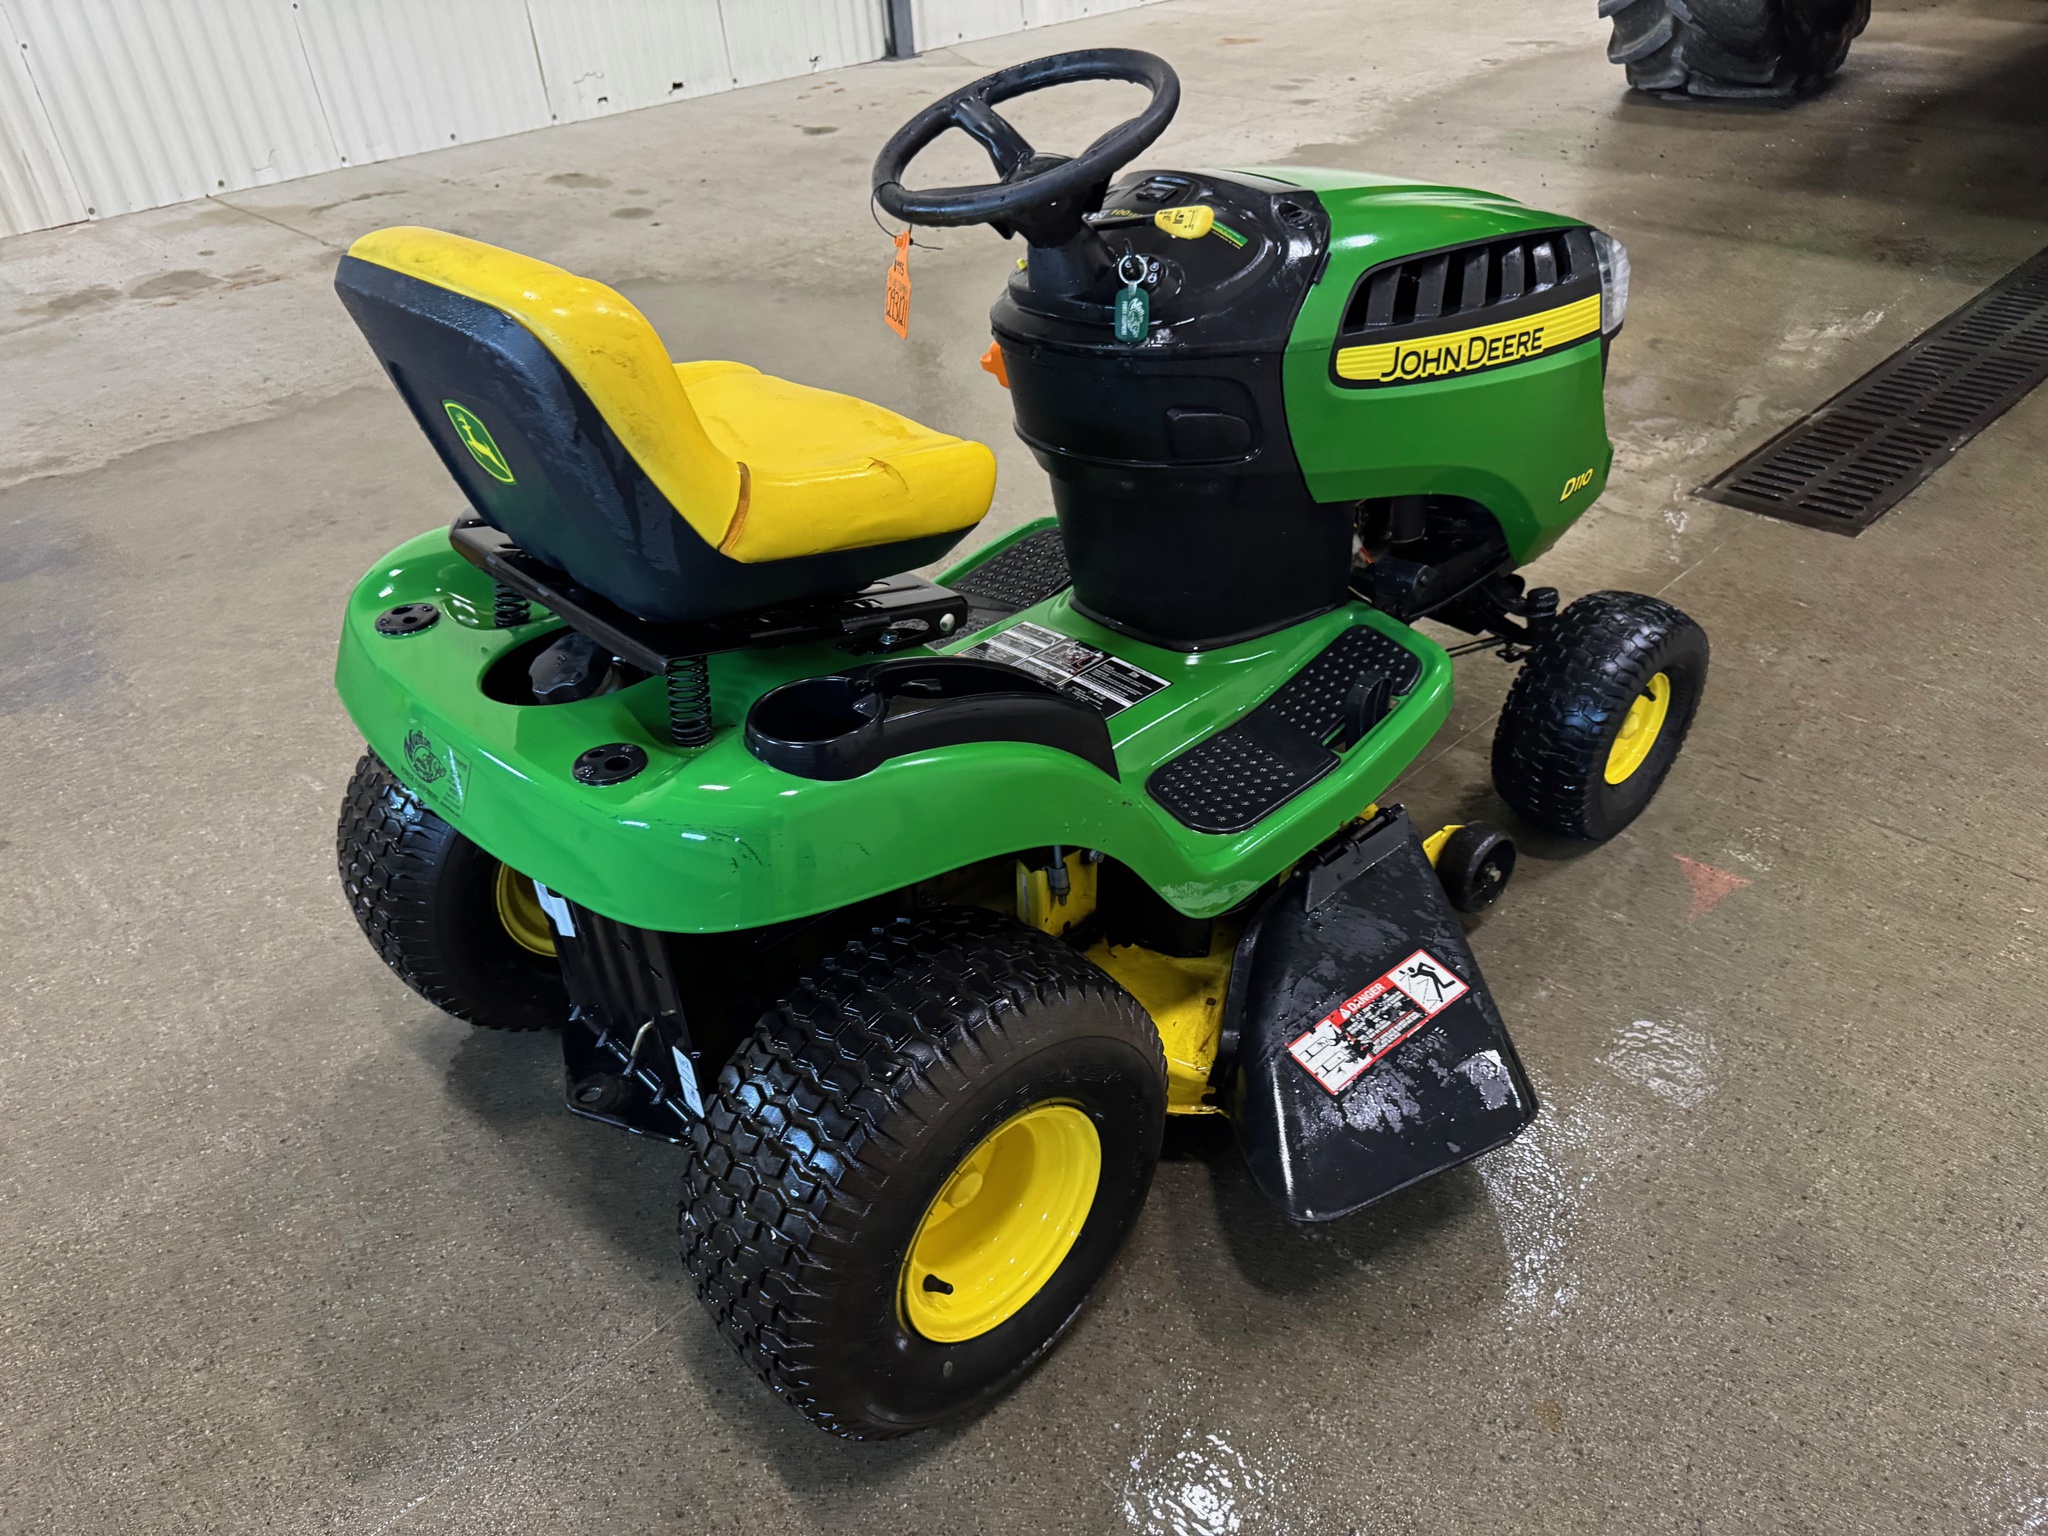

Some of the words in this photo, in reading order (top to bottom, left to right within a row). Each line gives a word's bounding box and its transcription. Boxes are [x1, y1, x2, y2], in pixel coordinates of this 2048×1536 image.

[1380, 345, 1463, 378] JOHN
[1467, 327, 1545, 366] DEERE
[1560, 468, 1594, 503] D110
